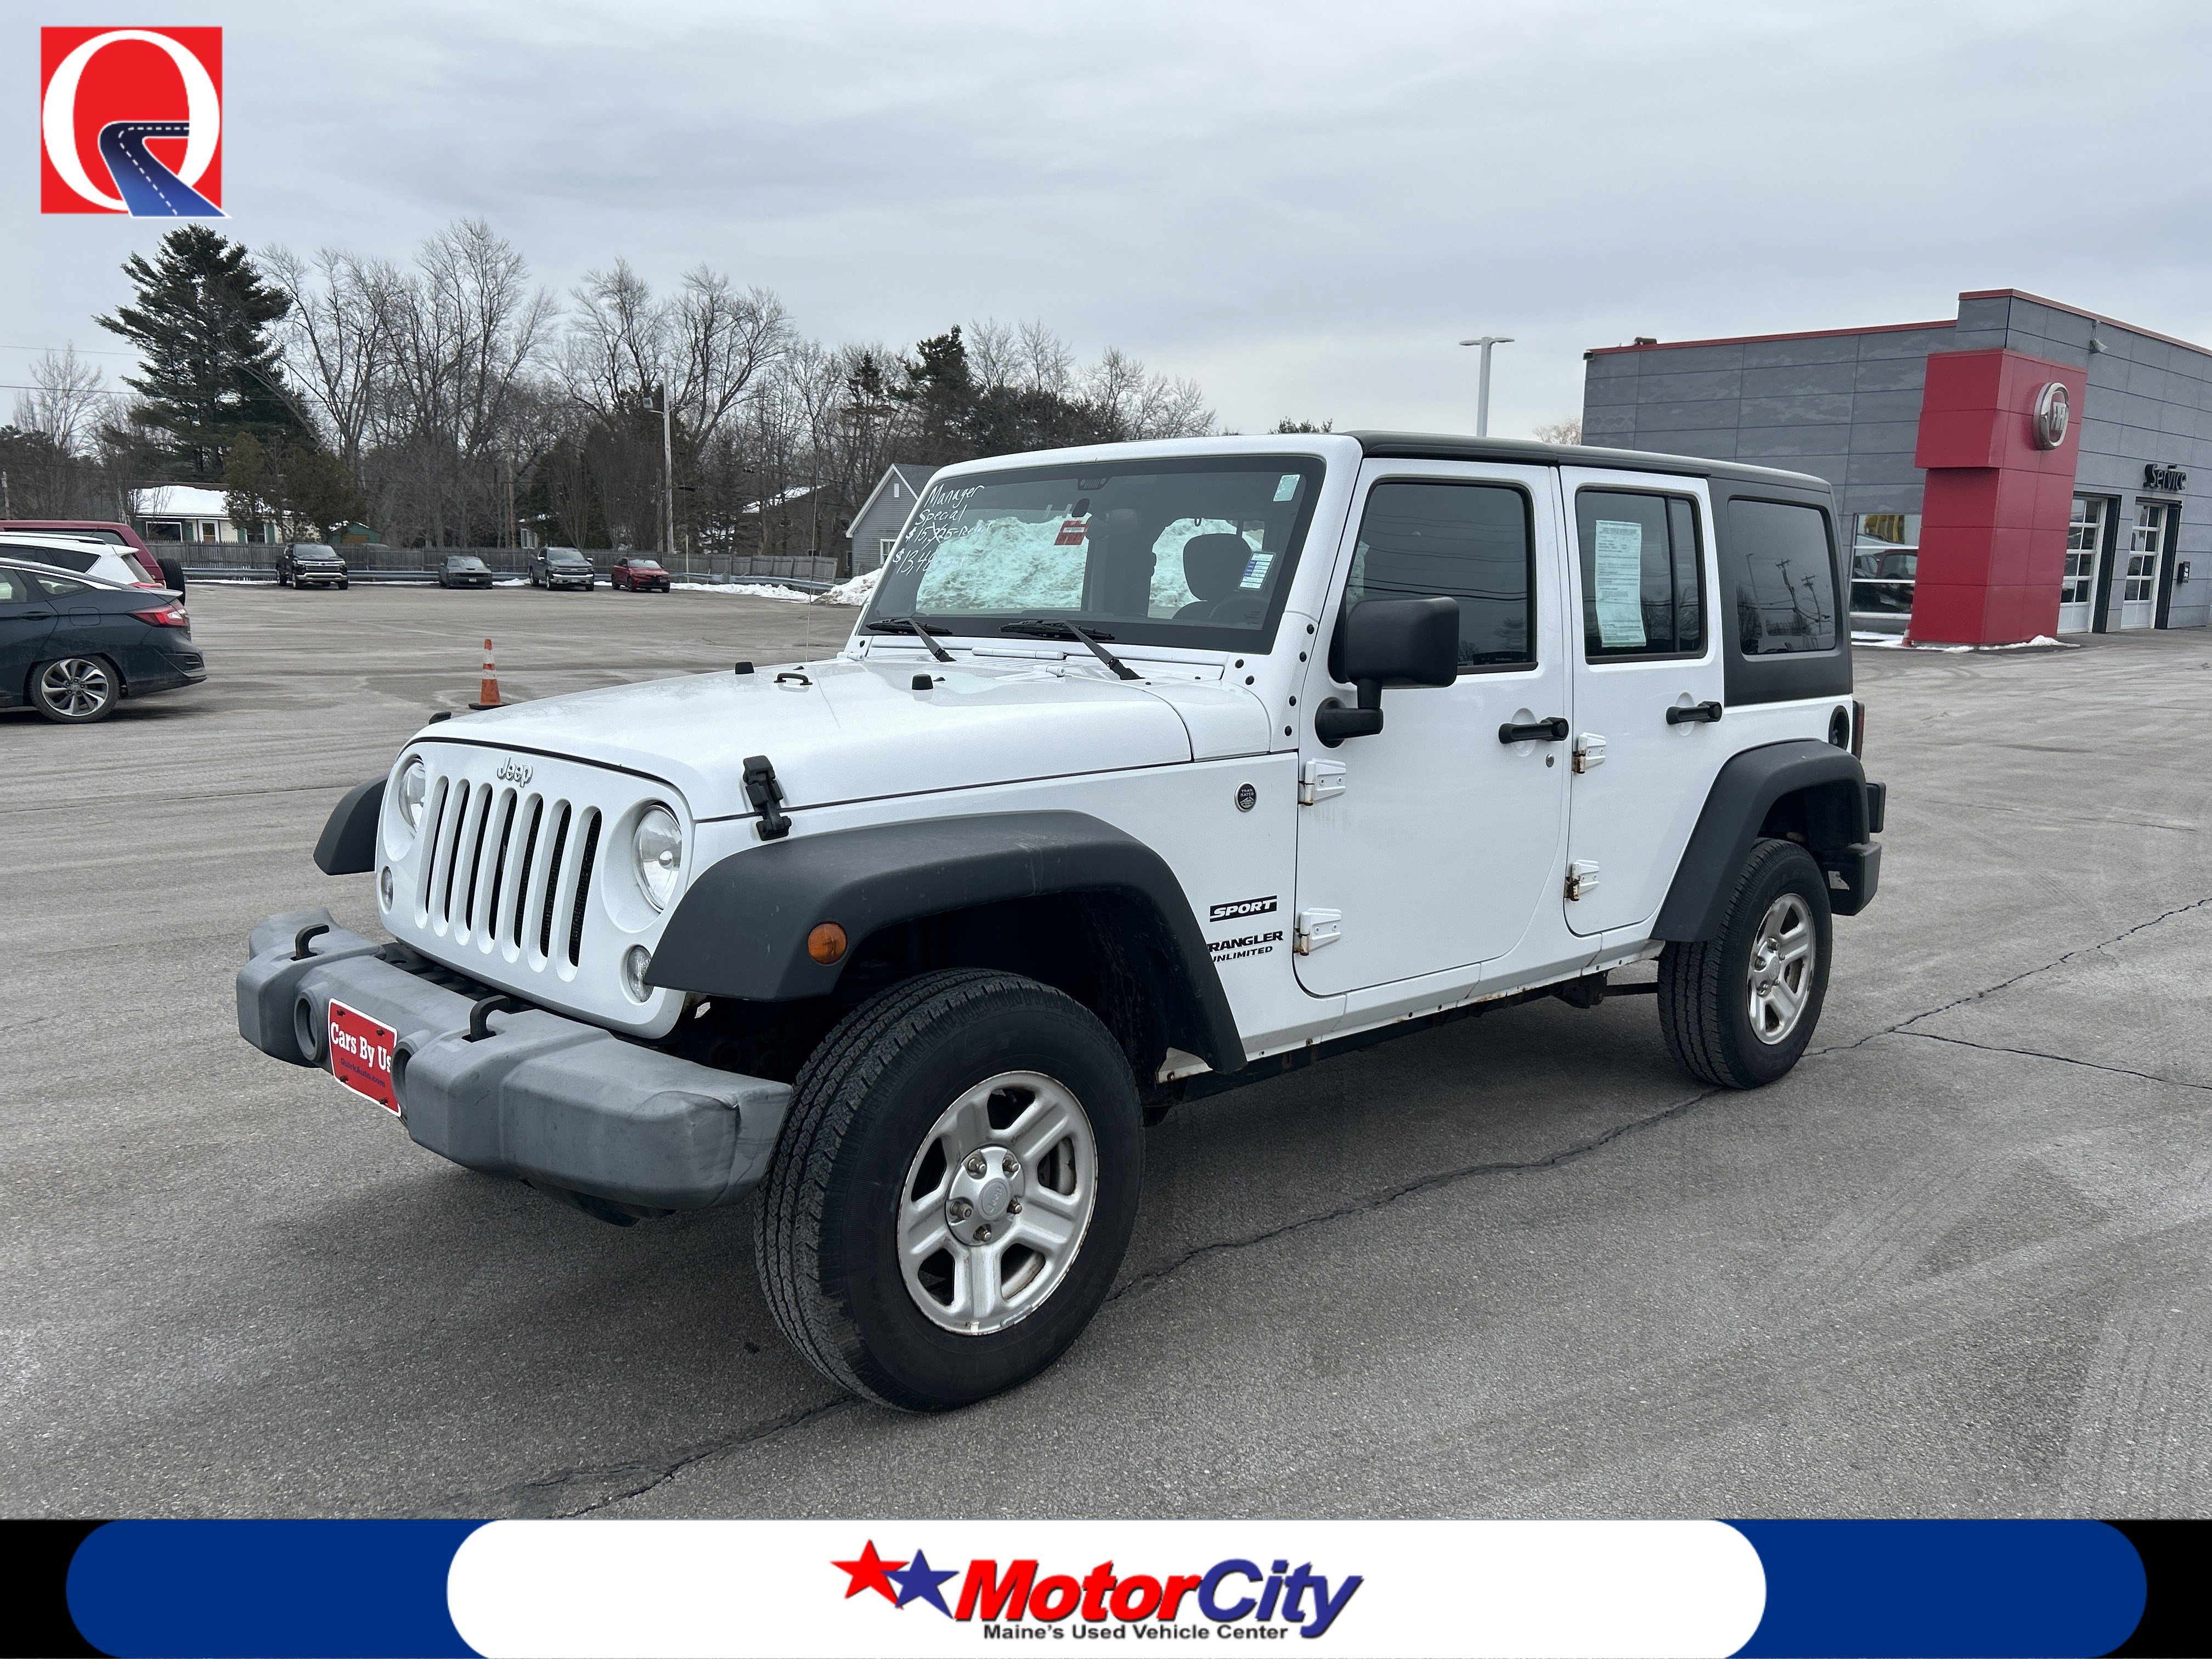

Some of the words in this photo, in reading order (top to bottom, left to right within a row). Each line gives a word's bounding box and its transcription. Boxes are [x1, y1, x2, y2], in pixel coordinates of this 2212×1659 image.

[2143, 463, 2187, 490] Service
[924, 483, 985, 509] Manager
[915, 504, 968, 528] Special
[497, 757, 533, 788] Jeep
[1210, 899, 1277, 919] SPORT
[1206, 930, 1284, 952] RANGLER
[330, 1022, 357, 1055] Cars
[359, 1035, 375, 1068] By
[377, 1045, 392, 1073] Us
[340, 1057, 386, 1088] QuirkAuto.com
